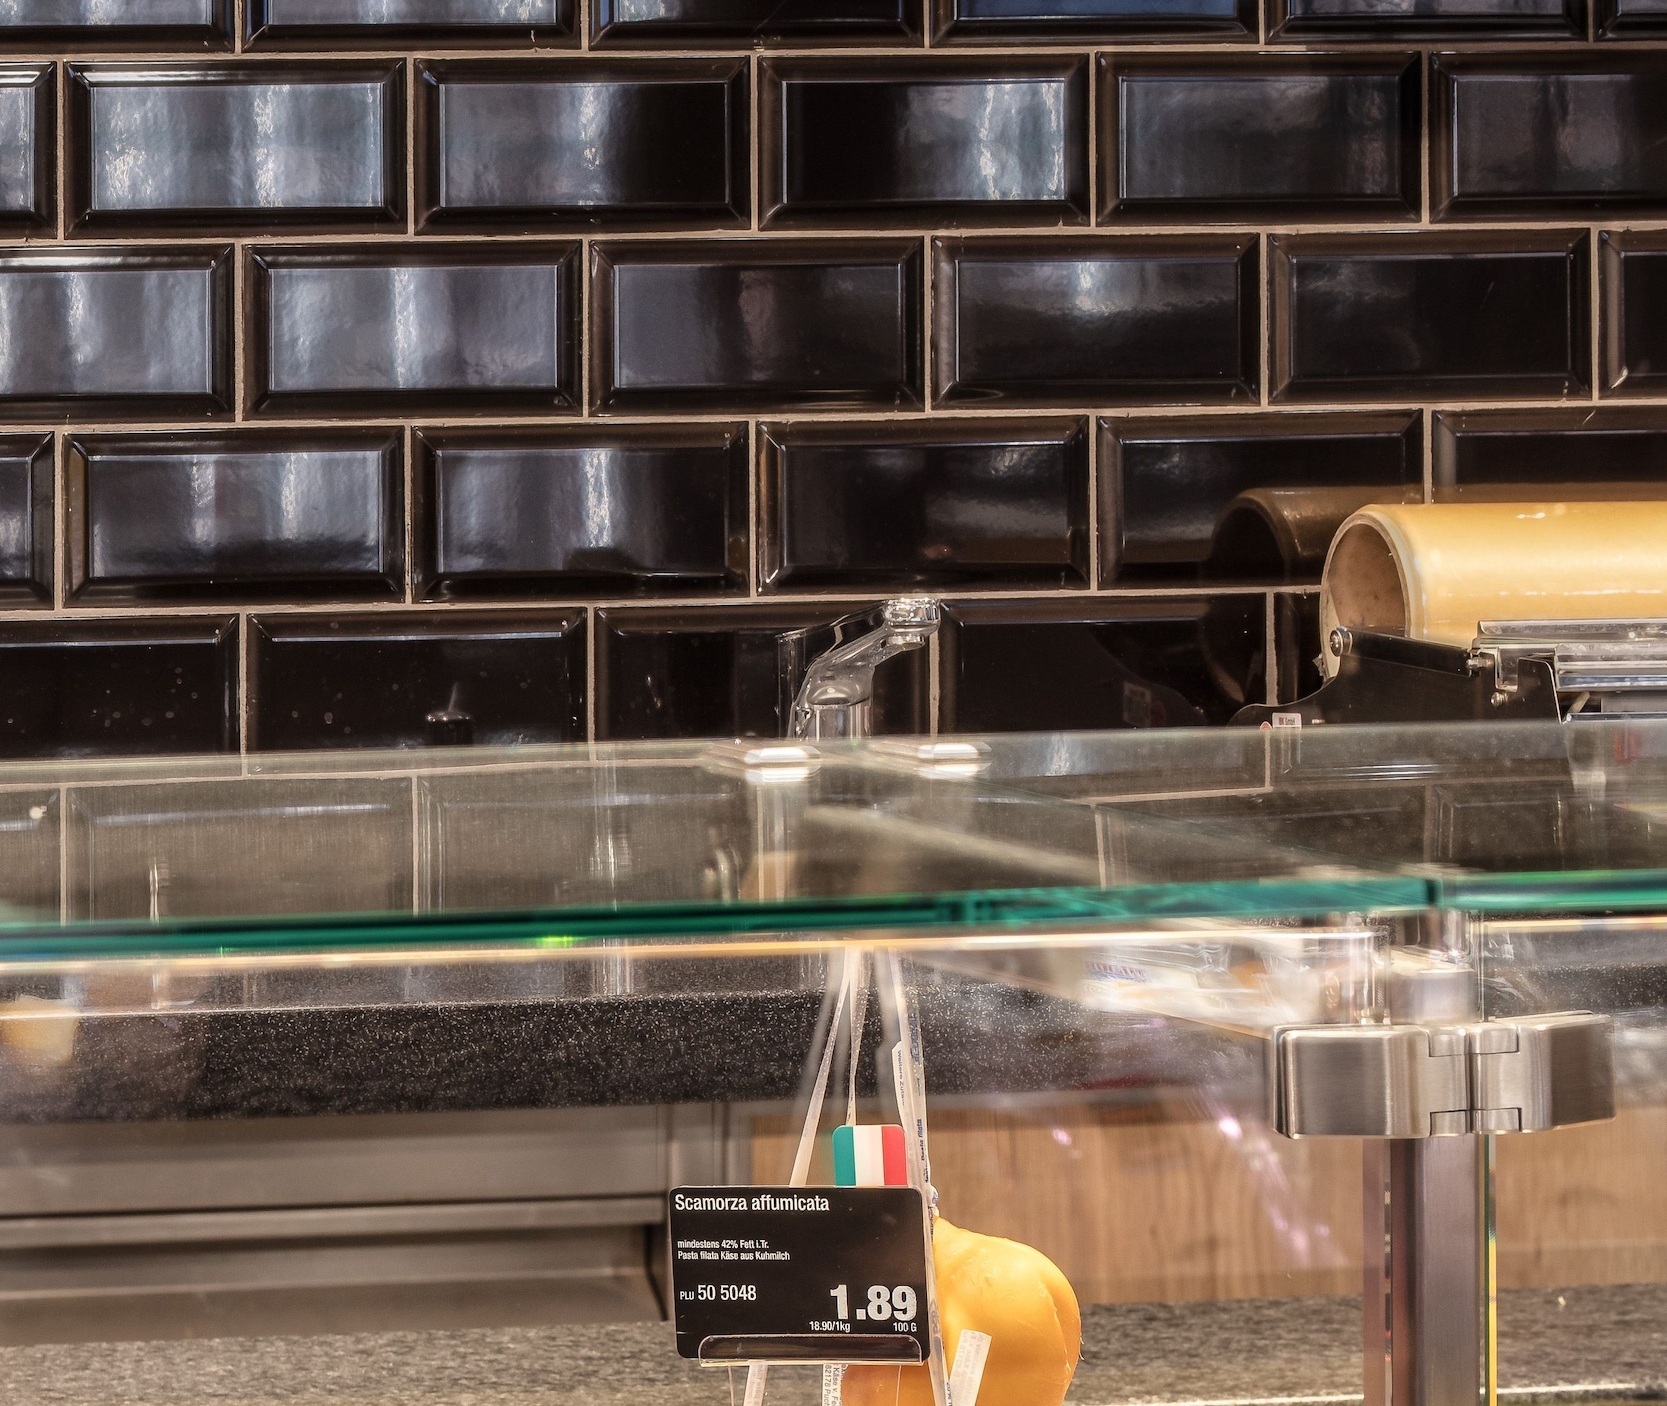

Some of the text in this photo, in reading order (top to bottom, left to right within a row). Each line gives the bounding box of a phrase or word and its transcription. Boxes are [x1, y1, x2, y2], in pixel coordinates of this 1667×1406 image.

[675, 1193, 830, 1211] Scamorza affumicata
[677, 1250, 790, 1260] Pasta filata Käse aus Kuhmilch
[679, 1284, 756, 1301] PLU 50 5048
[830, 1284, 917, 1321] 1.89
[809, 1320, 850, 1333] 18.90/1kg
[892, 1321, 917, 1332] 100 G
